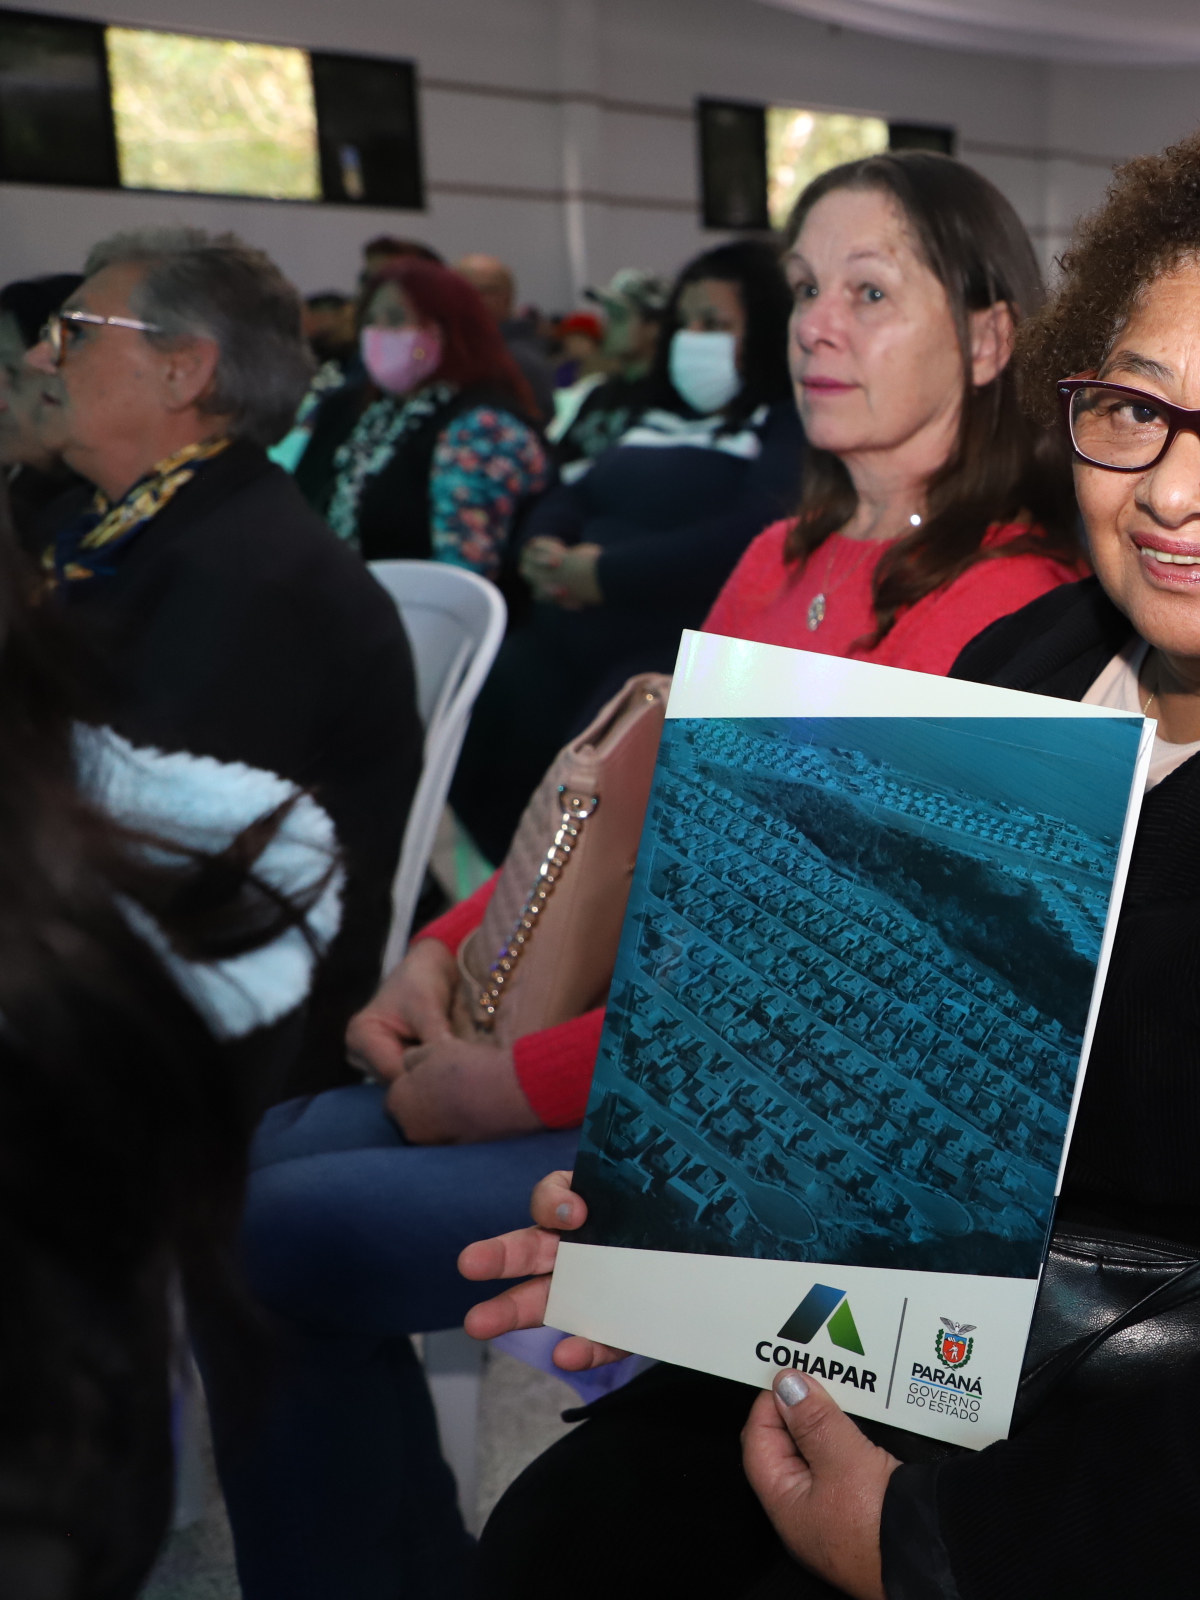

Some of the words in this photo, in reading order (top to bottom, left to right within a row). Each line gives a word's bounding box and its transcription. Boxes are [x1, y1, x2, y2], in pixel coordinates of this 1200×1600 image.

[755, 1341, 877, 1393] COHAPAR
[911, 1362, 982, 1395] PARANÁ
[906, 1393, 926, 1407] DO
[928, 1400, 979, 1423] ESTADO
[909, 1382, 980, 1411] GOVERNO
